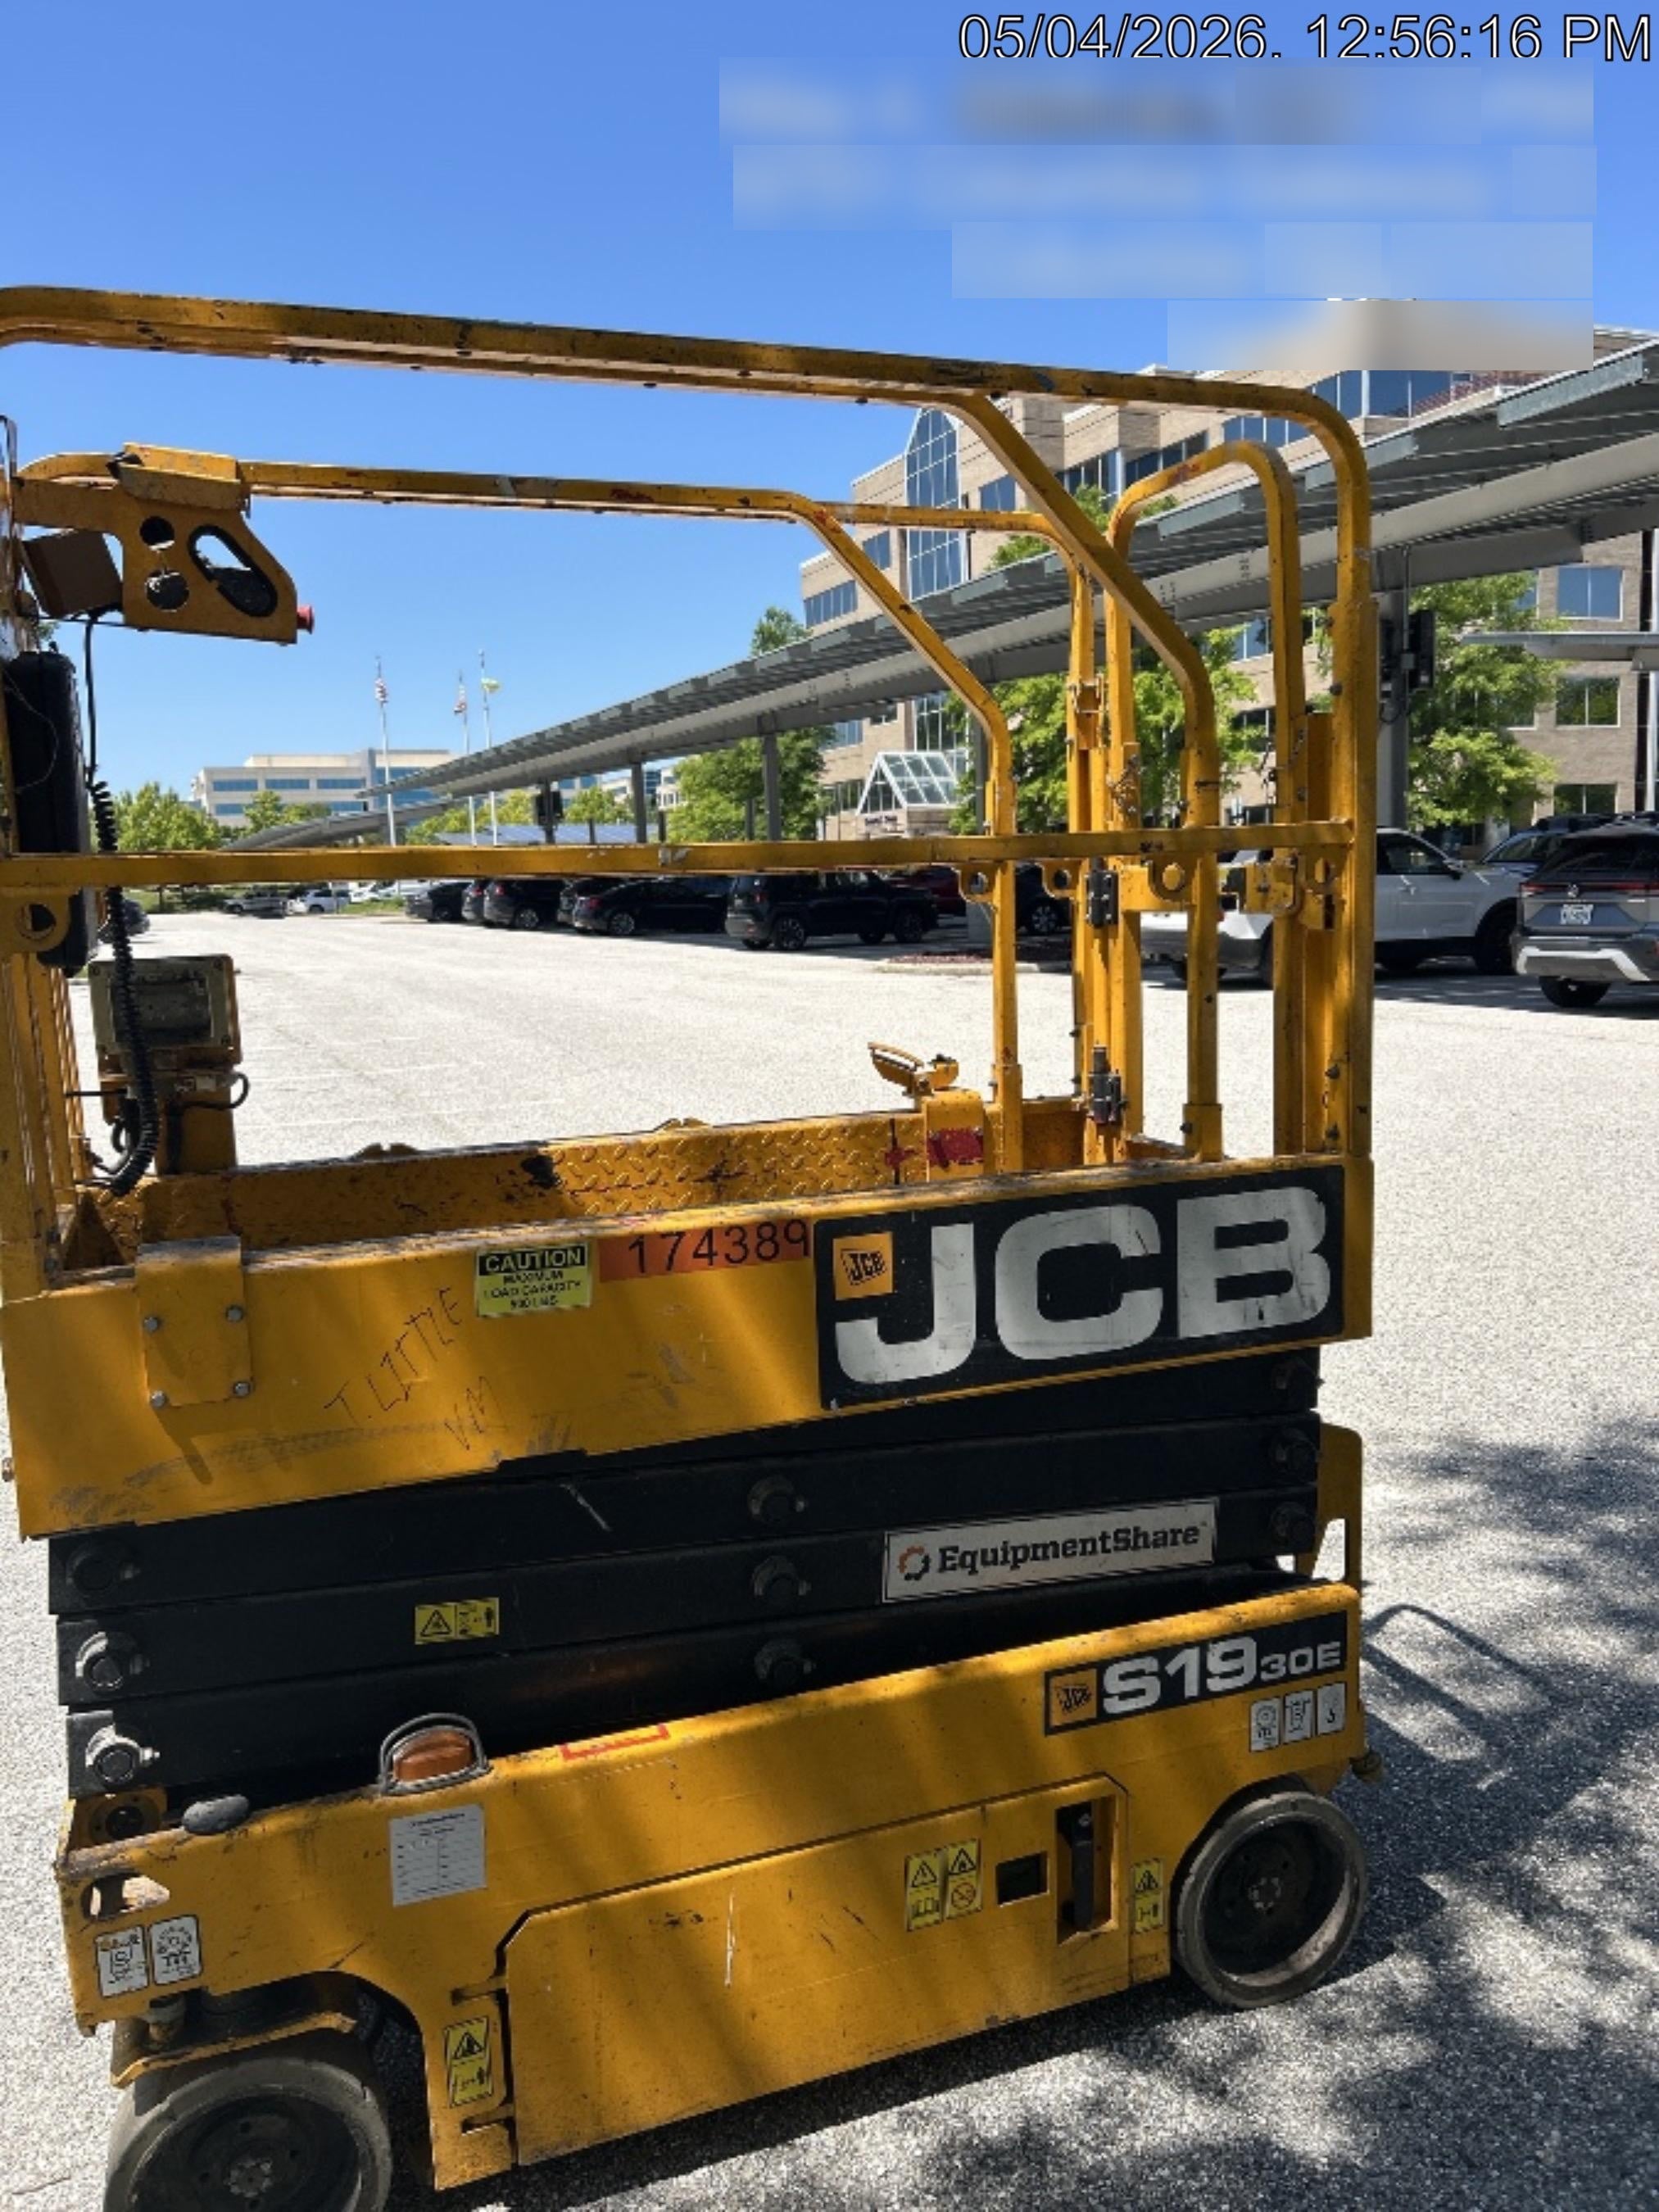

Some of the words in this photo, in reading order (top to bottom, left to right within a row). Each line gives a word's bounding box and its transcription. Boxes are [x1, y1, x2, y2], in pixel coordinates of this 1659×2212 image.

[485, 1248, 582, 1271] CAUTION
[628, 1218, 810, 1274] 174389
[503, 1270, 564, 1285] MAXIMUM
[846, 1251, 885, 1282] JCB
[483, 1286, 519, 1299] LOAD
[834, 1185, 1332, 1385] JCB
[936, 1524, 1200, 1575] EquipmentShare
